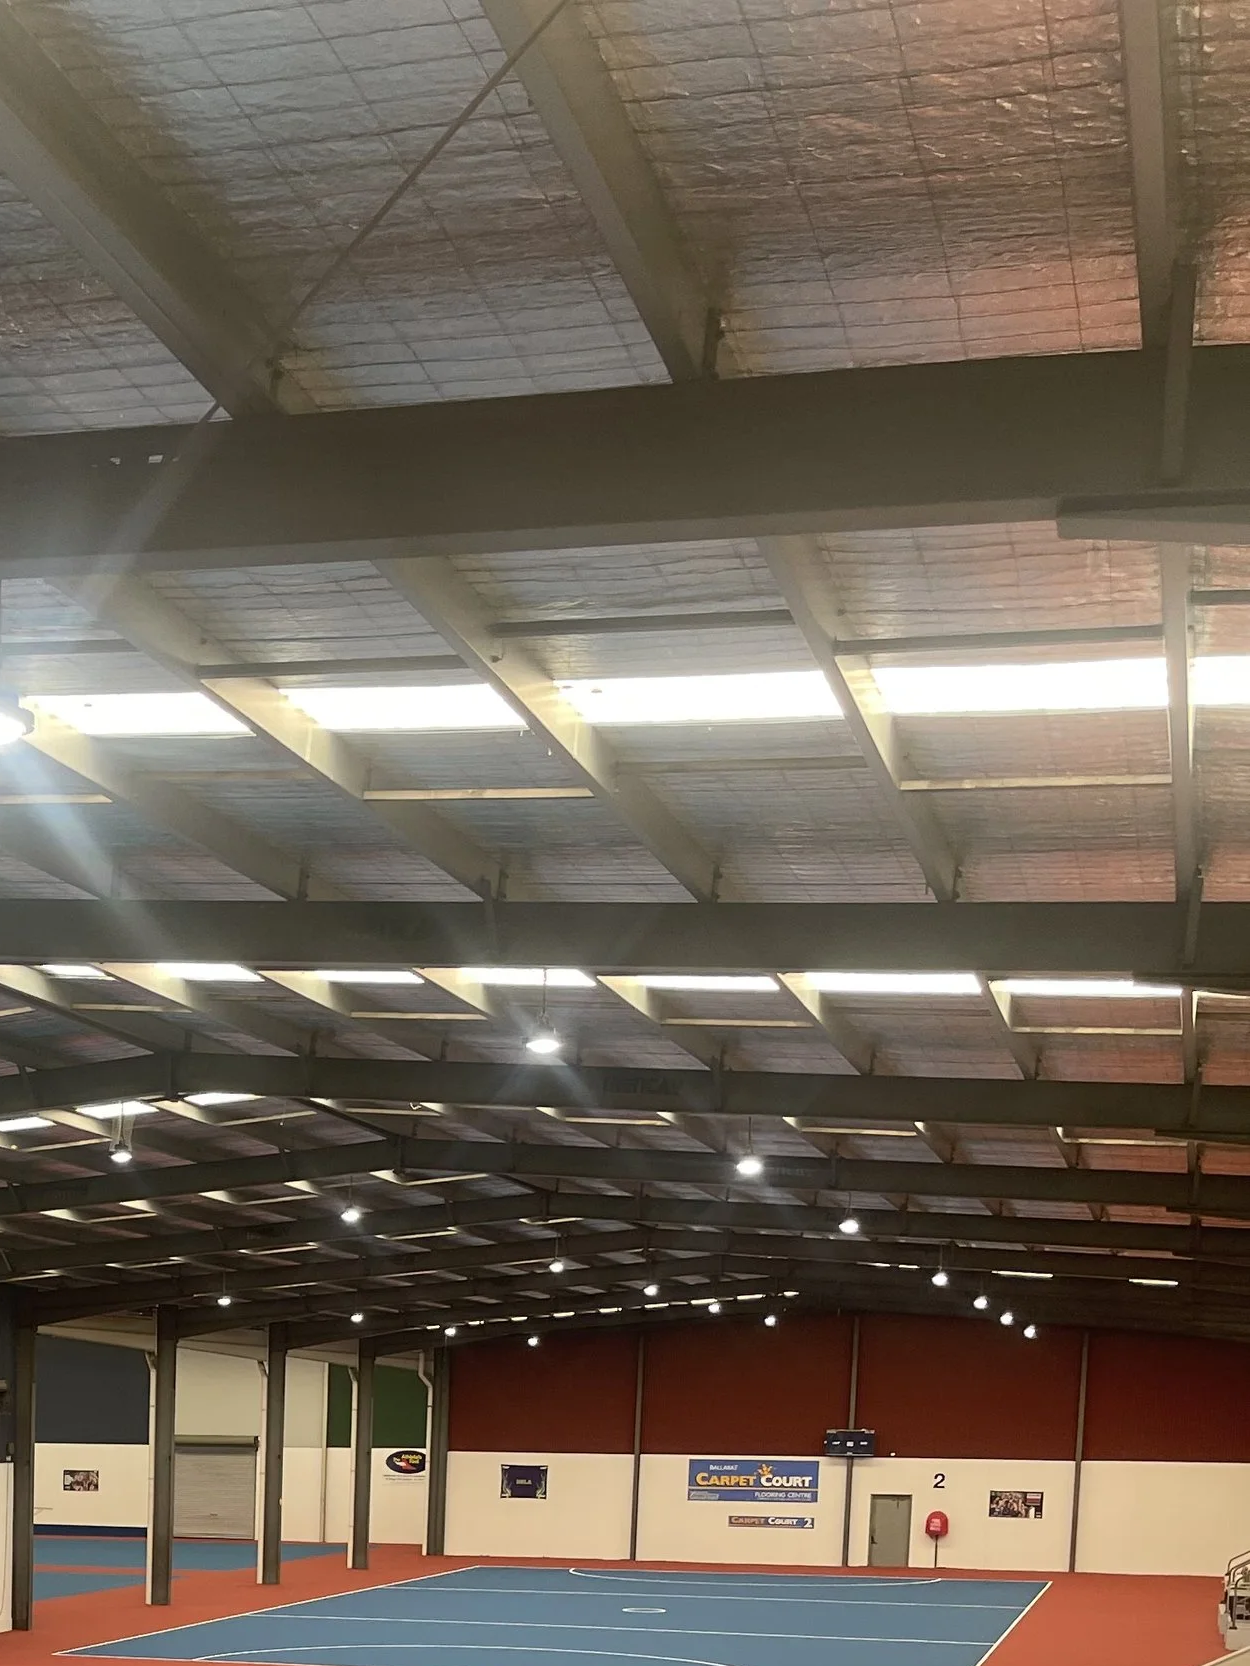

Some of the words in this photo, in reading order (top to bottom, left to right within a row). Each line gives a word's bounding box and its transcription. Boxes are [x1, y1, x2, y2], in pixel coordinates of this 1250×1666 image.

[696, 1472, 756, 1486] CARPET
[760, 1475, 813, 1487] COURT
[933, 1473, 945, 1488] 2
[731, 1517, 765, 1525] CARPET
[768, 1517, 798, 1525] COURT
[803, 1518, 813, 1528] 2
